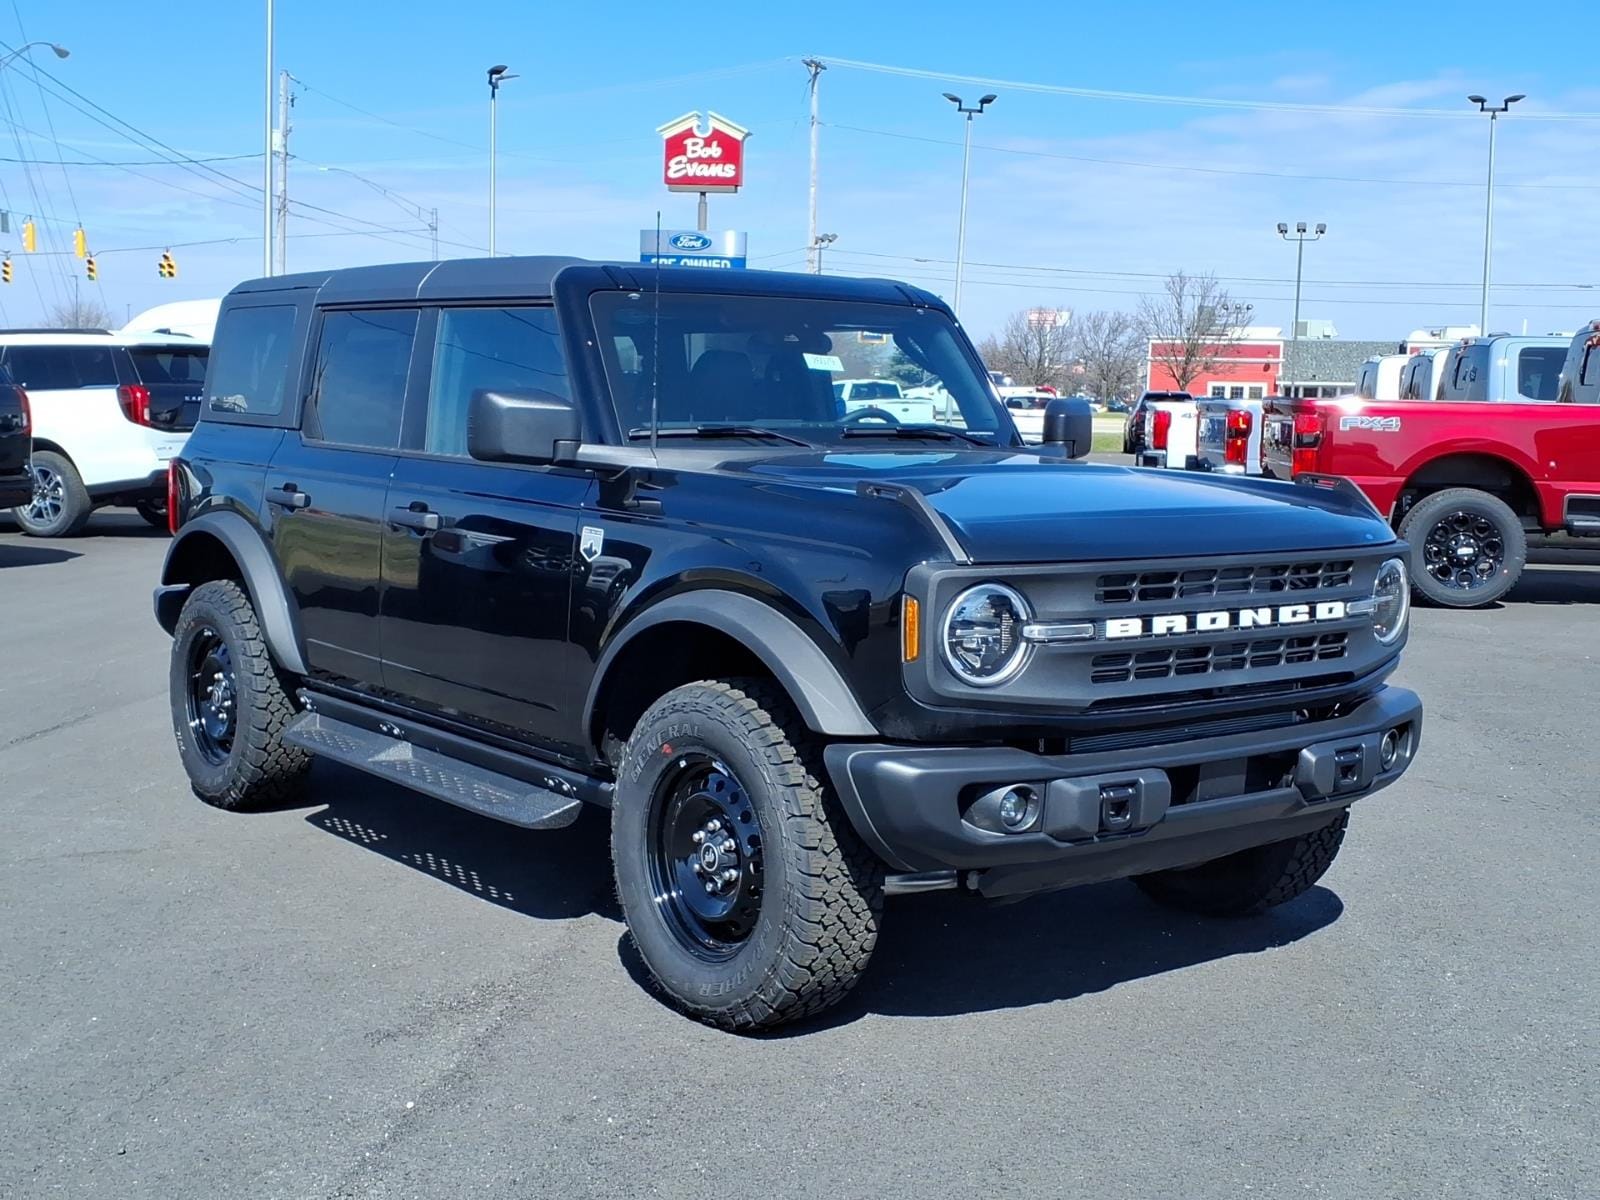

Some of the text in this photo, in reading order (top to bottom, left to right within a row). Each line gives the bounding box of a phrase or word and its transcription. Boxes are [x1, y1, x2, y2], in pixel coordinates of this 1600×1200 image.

[683, 137, 722, 158] Bob
[667, 155, 736, 179] Evans
[677, 235, 703, 248] Ford
[1340, 416, 1401, 431] FX4
[1105, 601, 1345, 638] BRONCO
[631, 723, 704, 783] GENERAL
